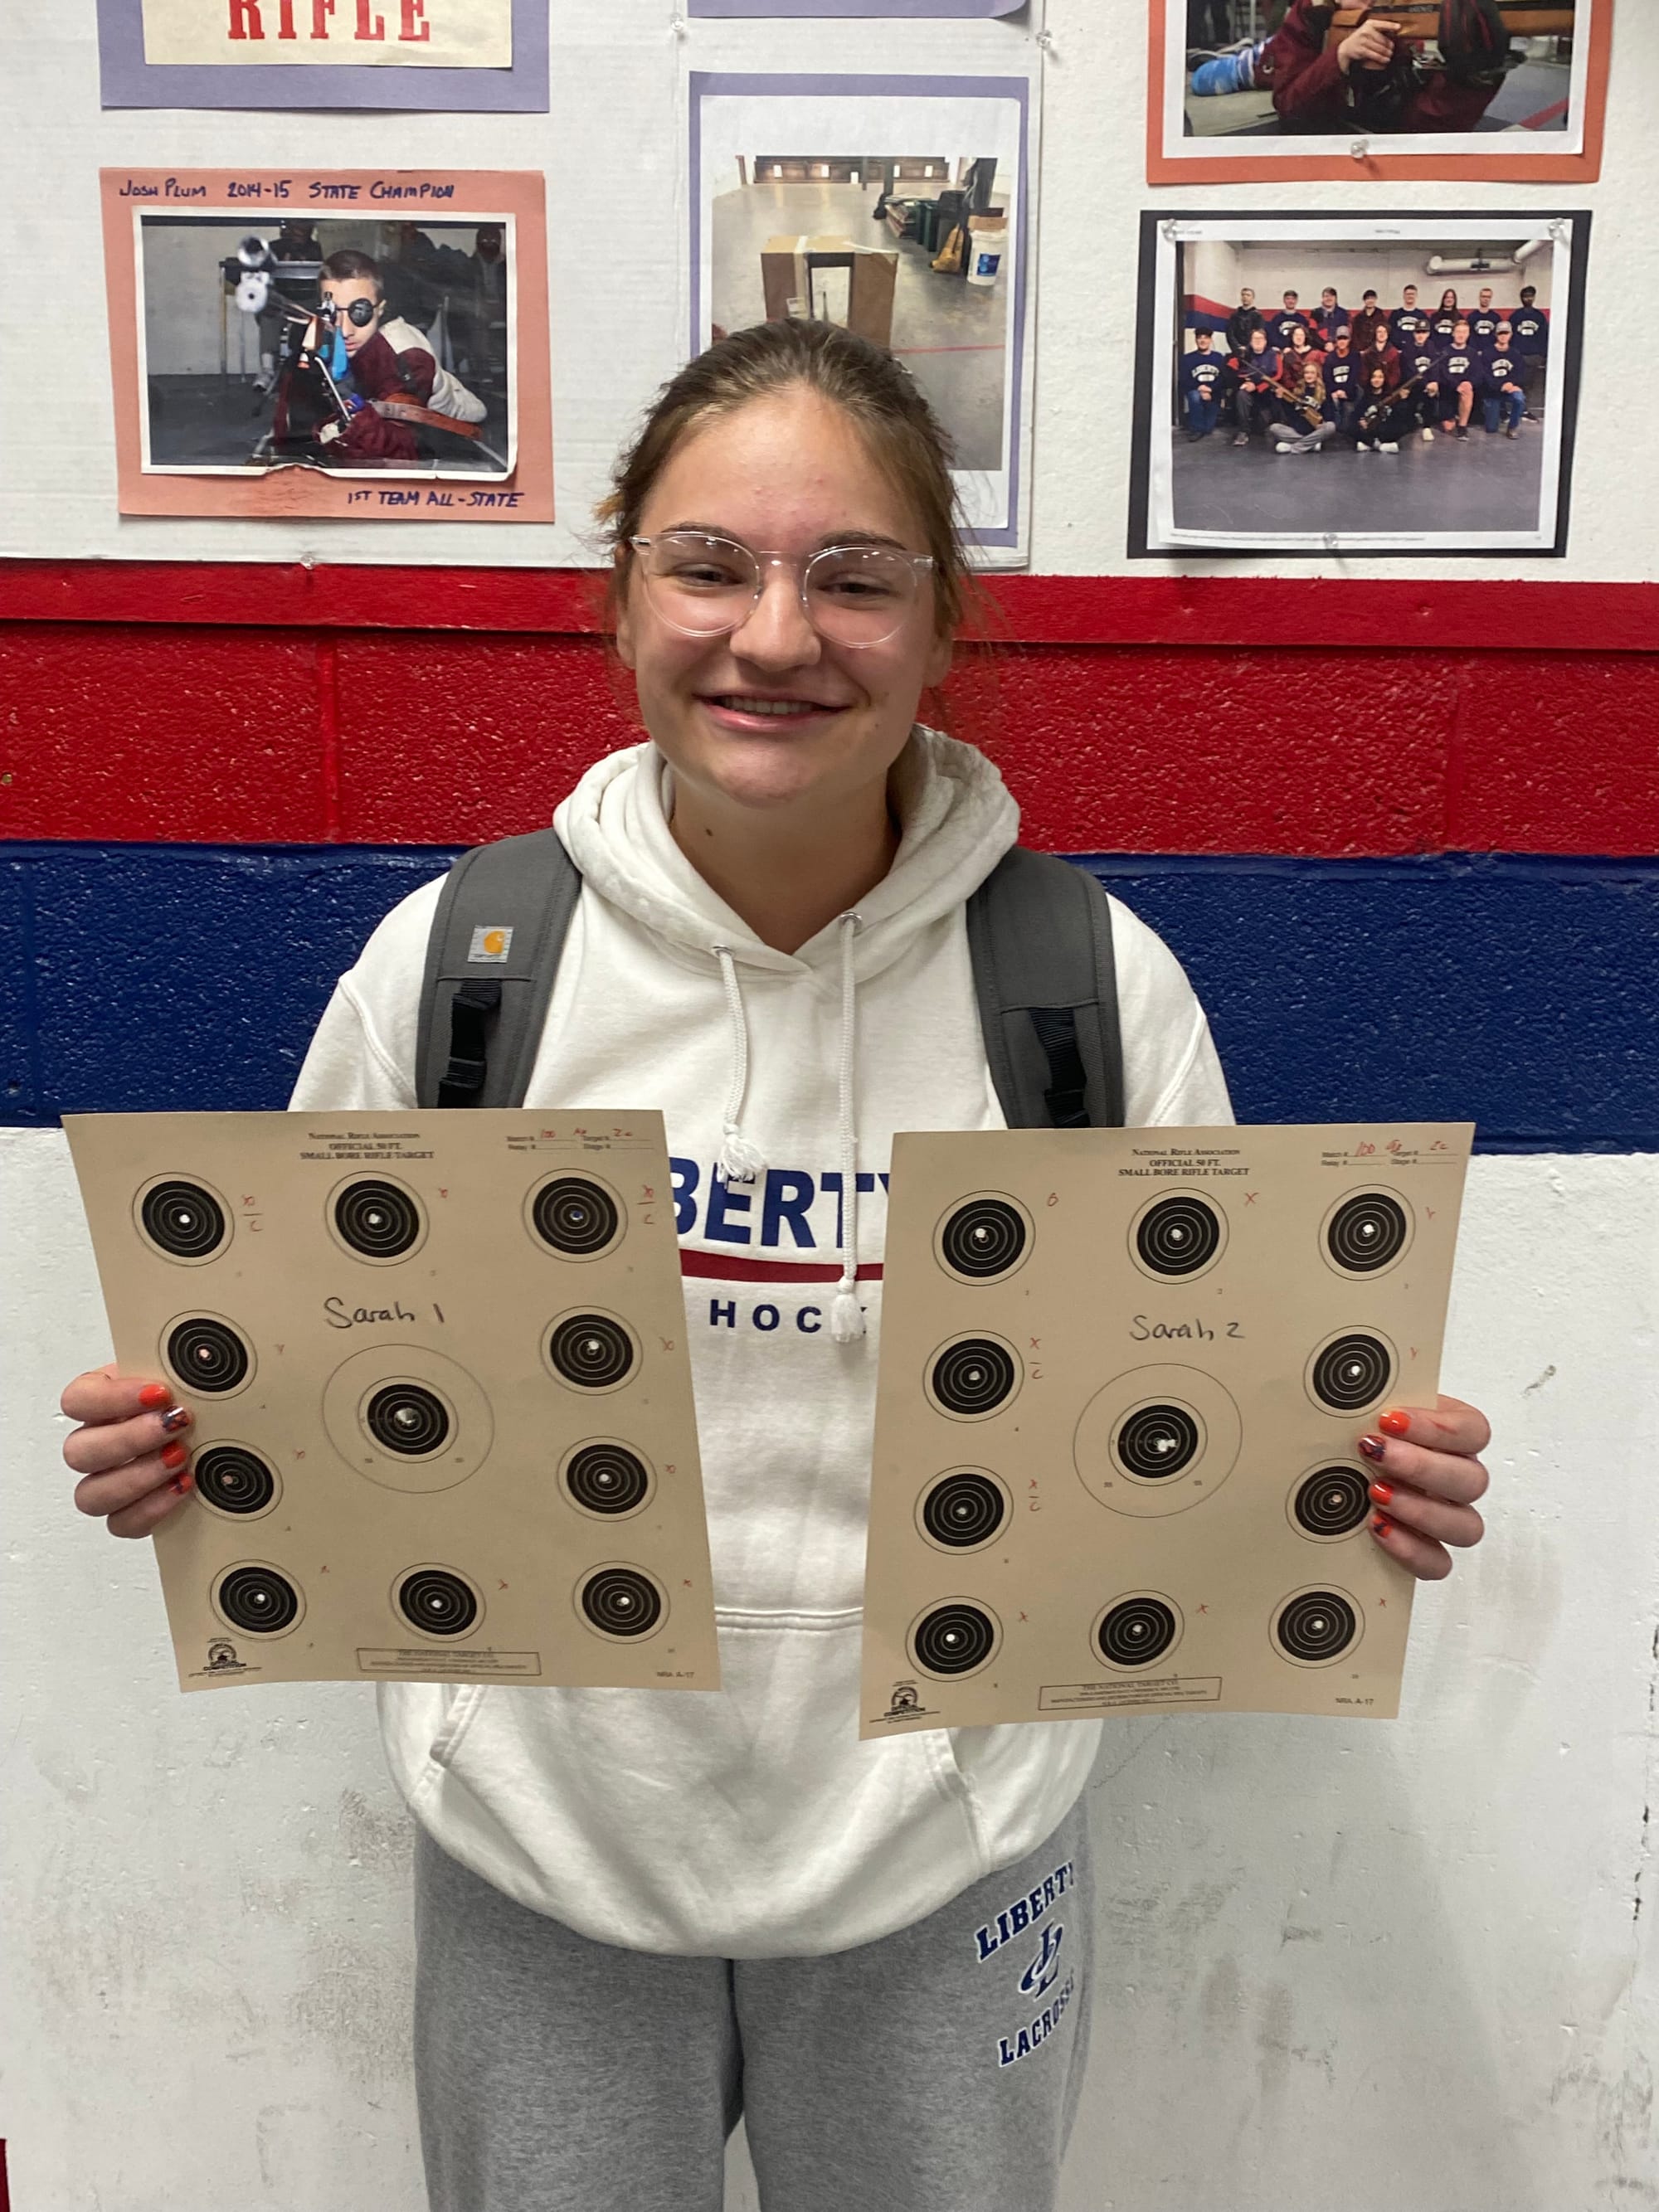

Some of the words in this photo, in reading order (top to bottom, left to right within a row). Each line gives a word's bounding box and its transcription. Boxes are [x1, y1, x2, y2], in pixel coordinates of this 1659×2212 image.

[228, 0, 430, 41] RIFLE
[226, 179, 292, 198] 2014-15
[309, 182, 362, 199] STATE
[378, 491, 420, 505] TEAM
[426, 490, 525, 508] ALL-STATE
[1181, 1168, 1209, 1176] RIFLE
[1212, 1168, 1250, 1176] TARGET
[324, 1296, 415, 1329] Sarah
[1129, 1315, 1214, 1341] Sarah
[1226, 1322, 1246, 1339] 2
